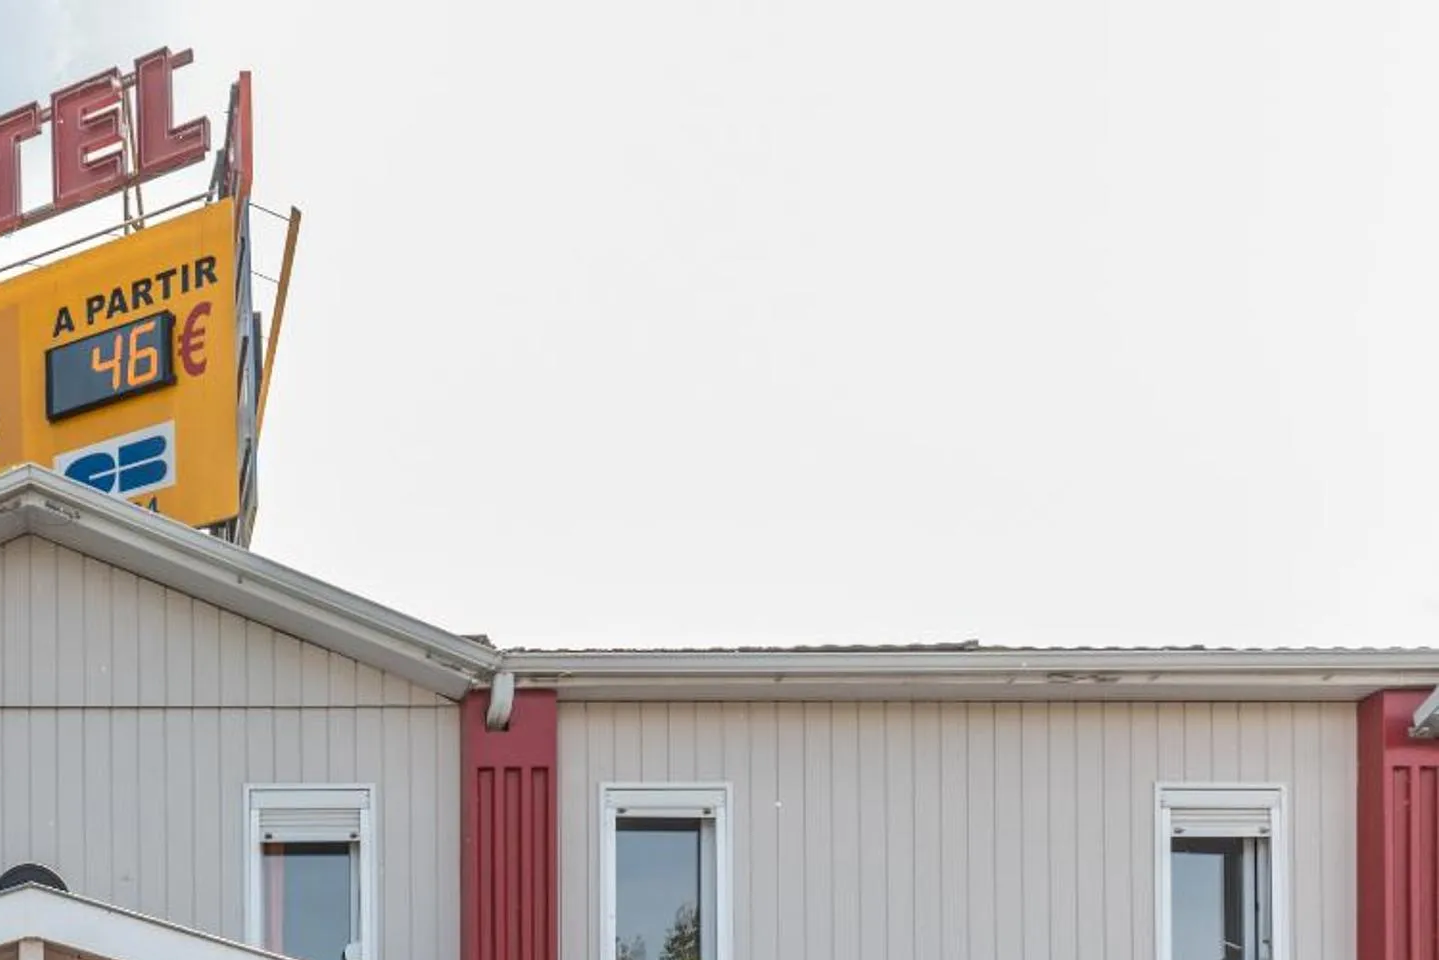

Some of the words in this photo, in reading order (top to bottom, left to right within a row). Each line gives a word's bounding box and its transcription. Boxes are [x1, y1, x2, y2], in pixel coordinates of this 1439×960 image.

[53, 306, 75, 338] A
[85, 255, 218, 325] PARTIR
[91, 320, 158, 391] 46
